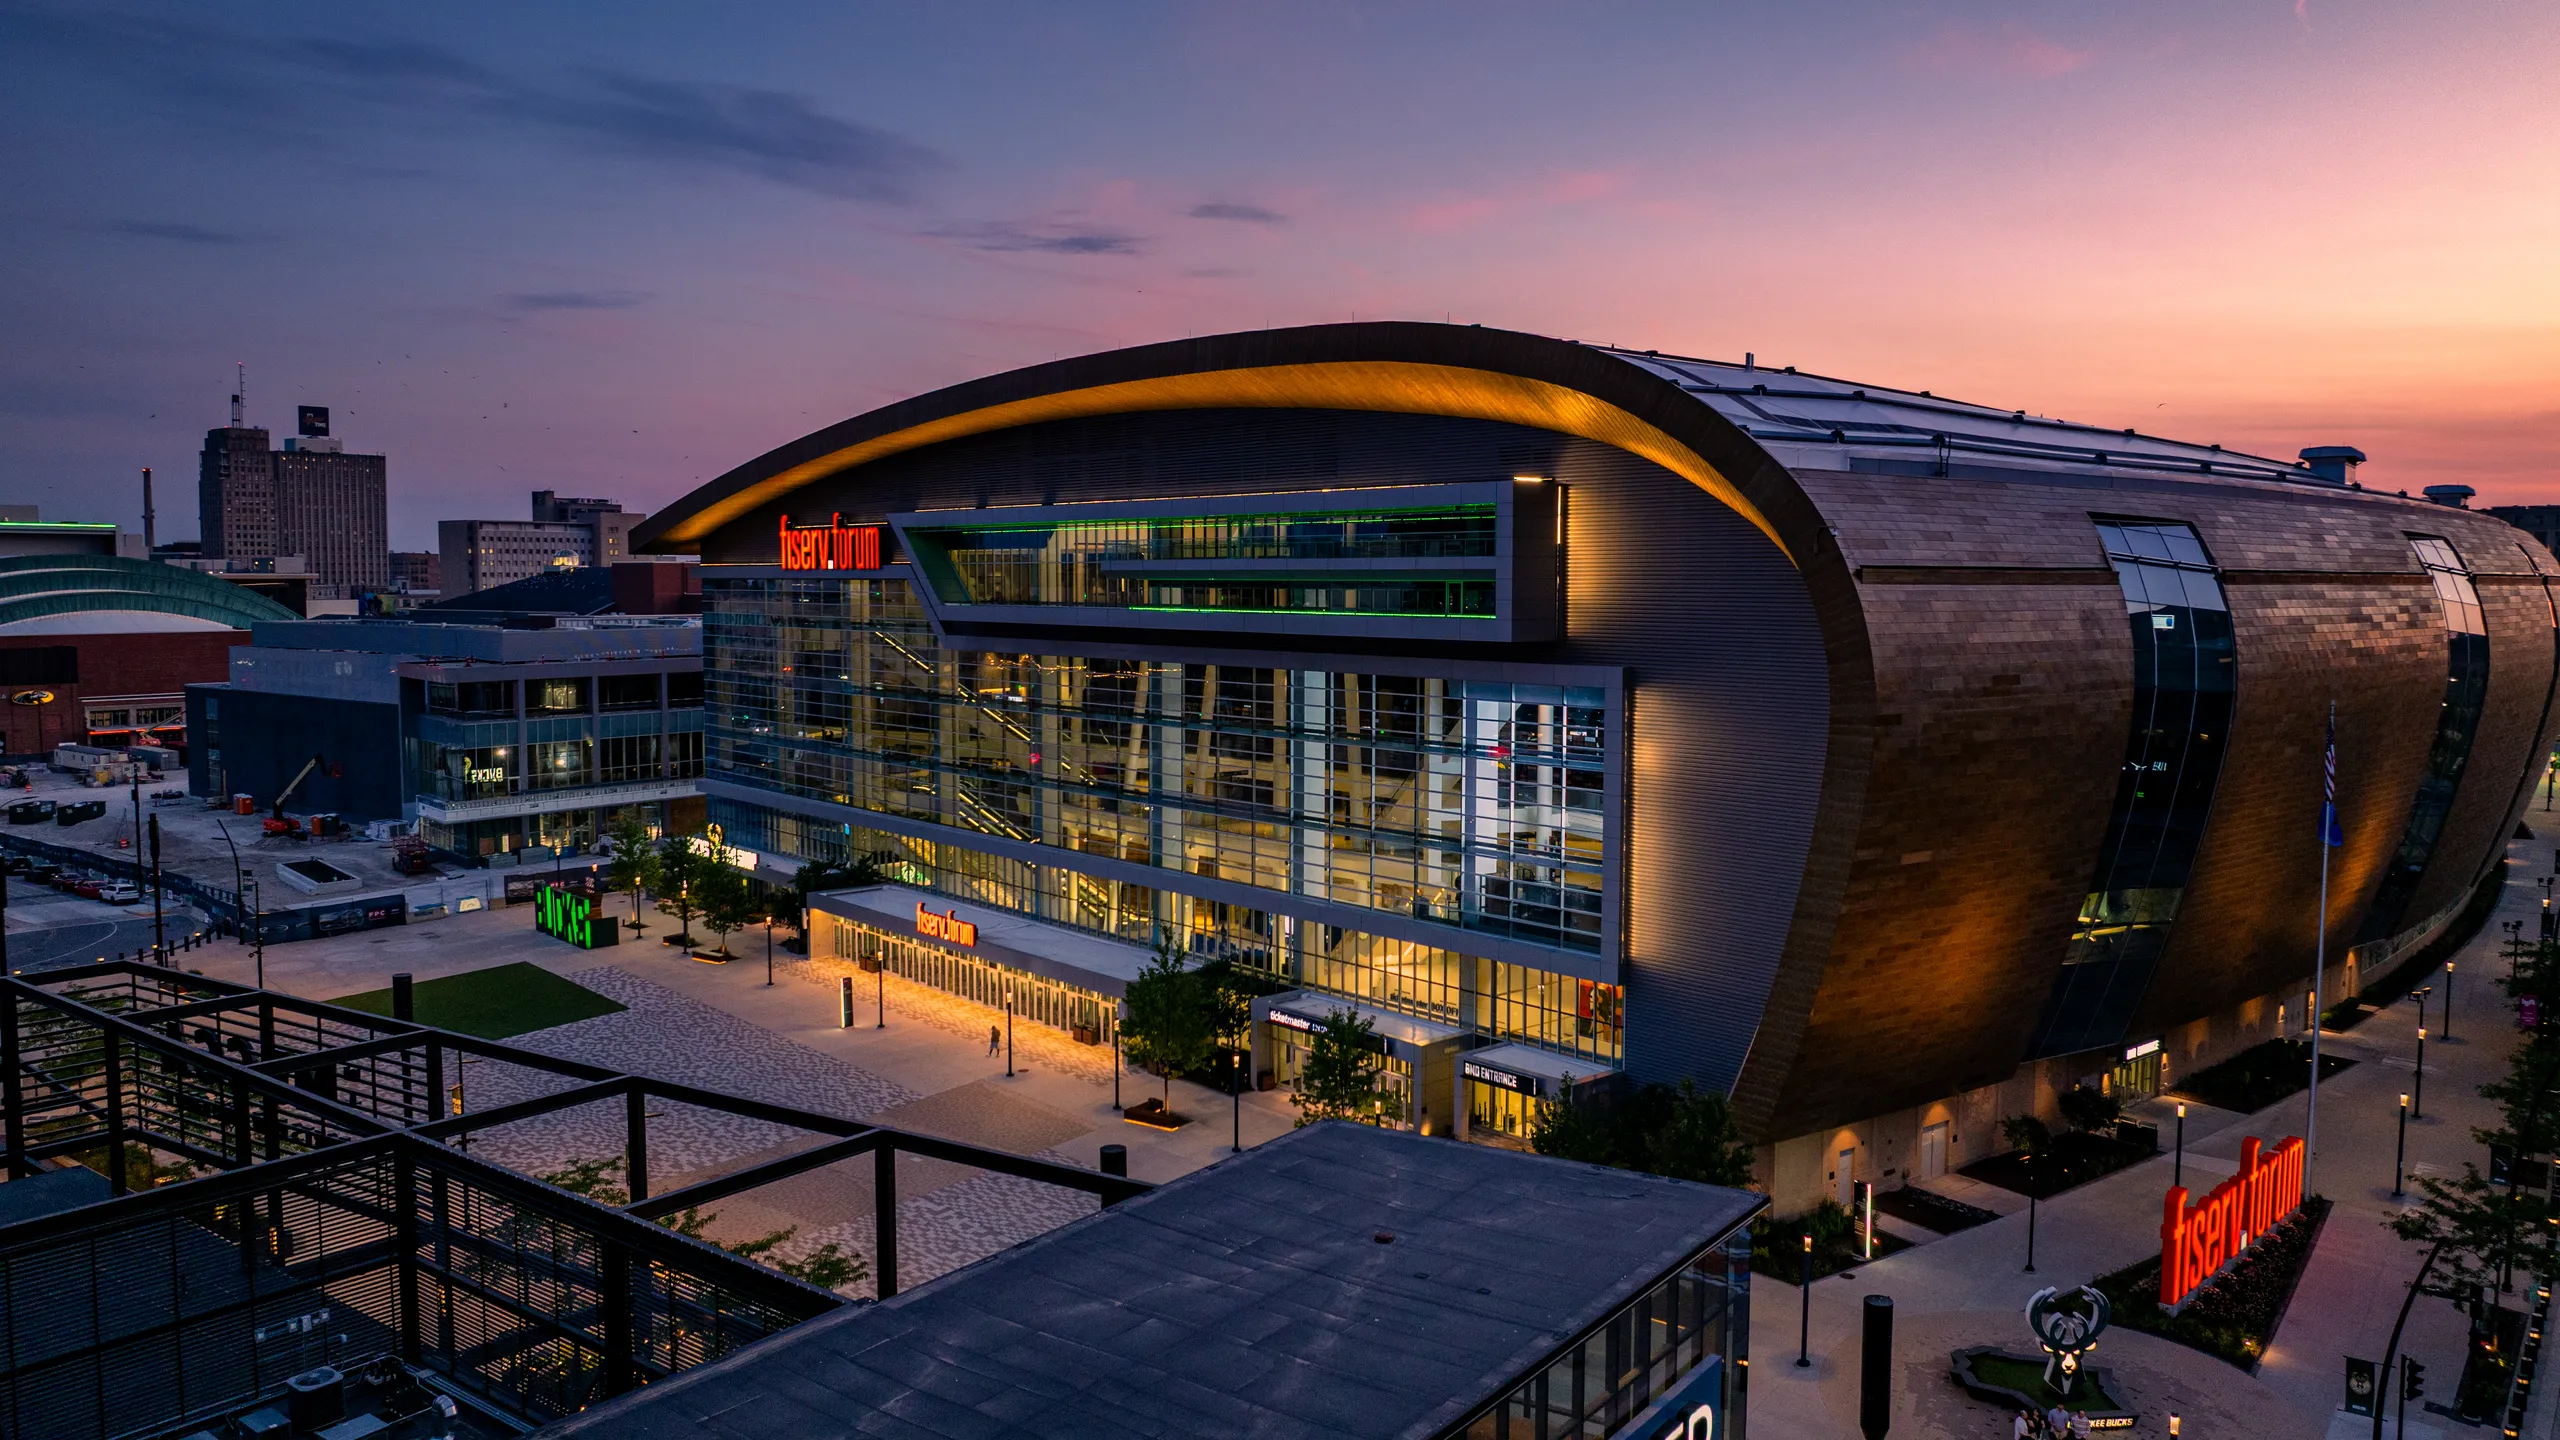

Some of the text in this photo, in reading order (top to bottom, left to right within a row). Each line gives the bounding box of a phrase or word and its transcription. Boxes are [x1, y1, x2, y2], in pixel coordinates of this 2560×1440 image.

[1270, 1010, 1310, 1030] ticketmaster
[1465, 1062, 1517, 1088] BMO ENTRANCE
[2106, 1418, 2133, 1428] BUCKS
